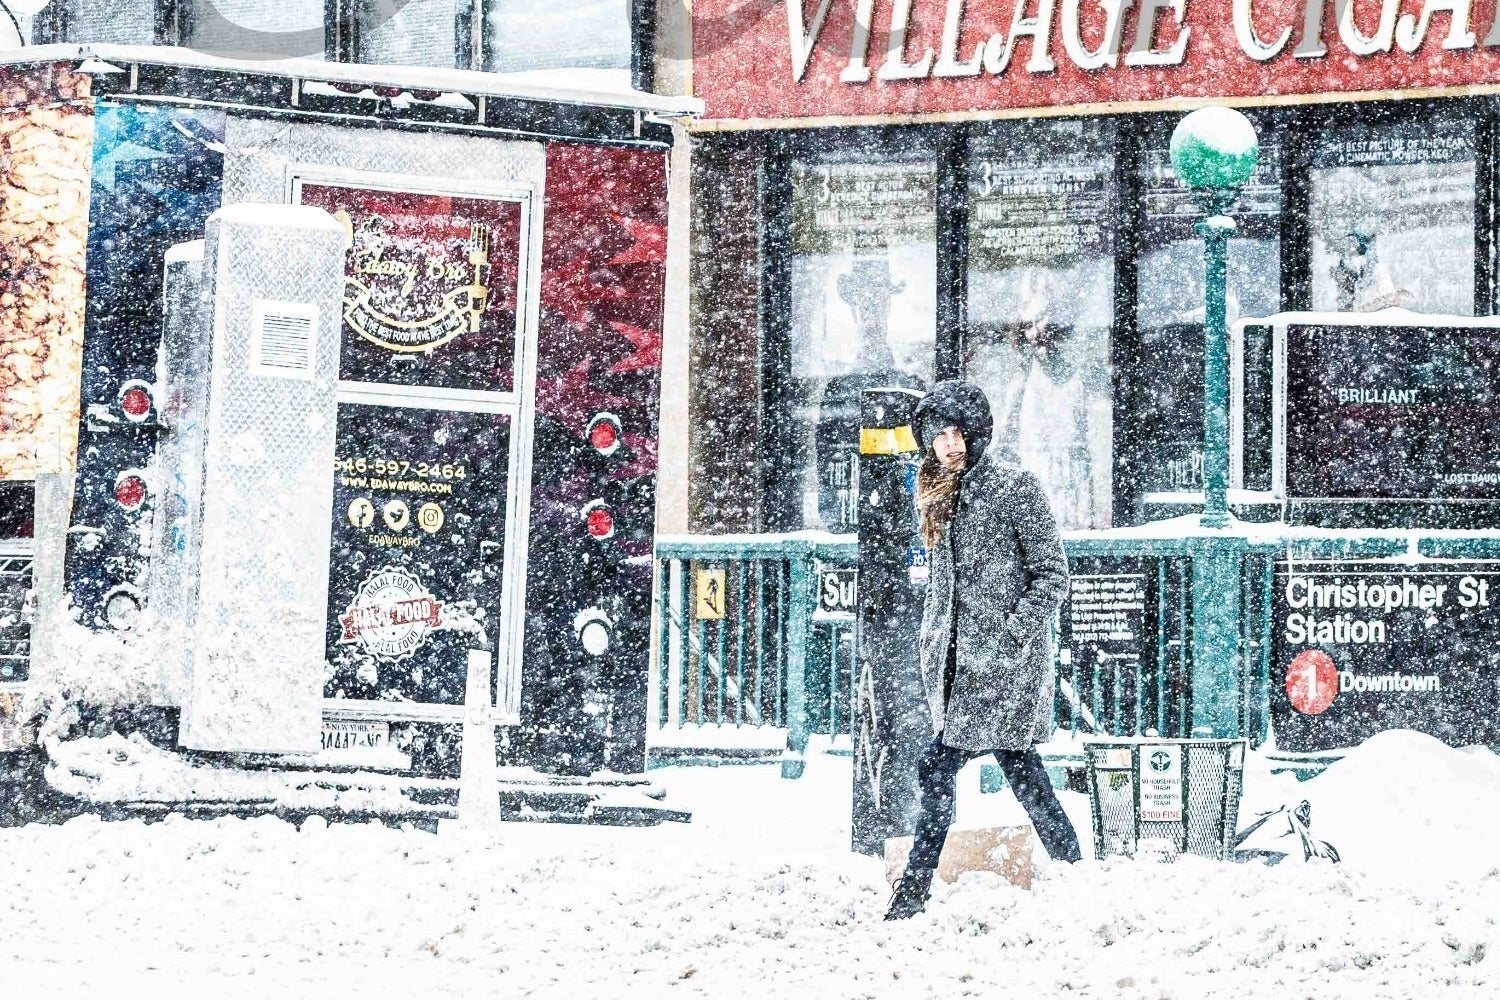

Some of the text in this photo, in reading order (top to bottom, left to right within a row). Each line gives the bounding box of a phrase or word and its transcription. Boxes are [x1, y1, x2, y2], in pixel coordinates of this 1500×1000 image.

[1346, 141, 1368, 153] BEST
[1369, 139, 1404, 152] PICTURE
[1444, 473, 1470, 484] LOST
[368, 534, 421, 546] EDAWAYBRO
[1286, 576, 1490, 613] Christopher St
[396, 600, 431, 622] FOOD
[1286, 613, 1385, 645] Station
[1305, 664, 1441, 701] 1 Downtown
[1142, 810, 1181, 819] $100 FINE
